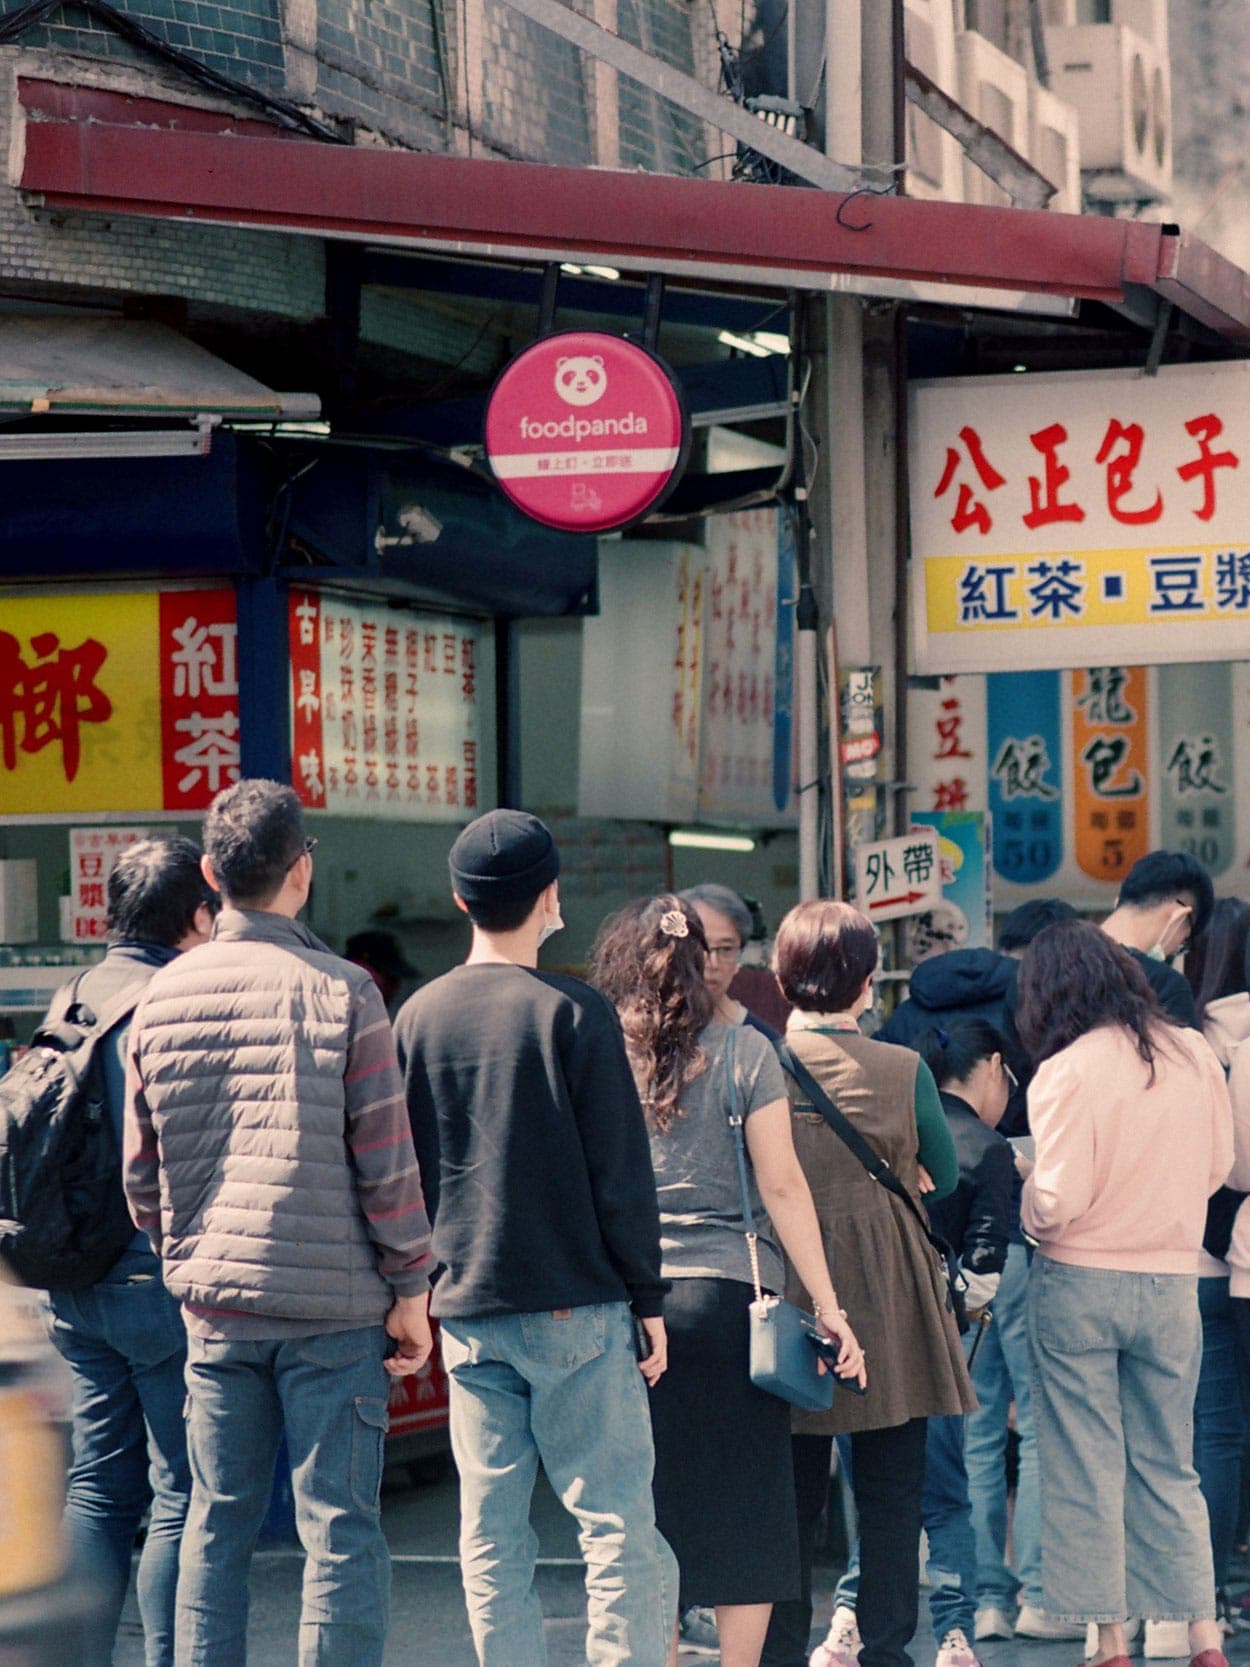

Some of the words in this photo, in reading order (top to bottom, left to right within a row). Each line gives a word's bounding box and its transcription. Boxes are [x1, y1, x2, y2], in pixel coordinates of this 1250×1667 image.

[520, 412, 648, 442] foodpanda
[171, 616, 240, 793] 紅茶
[296, 595, 324, 801] 古早味
[866, 841, 934, 895] 外帶
